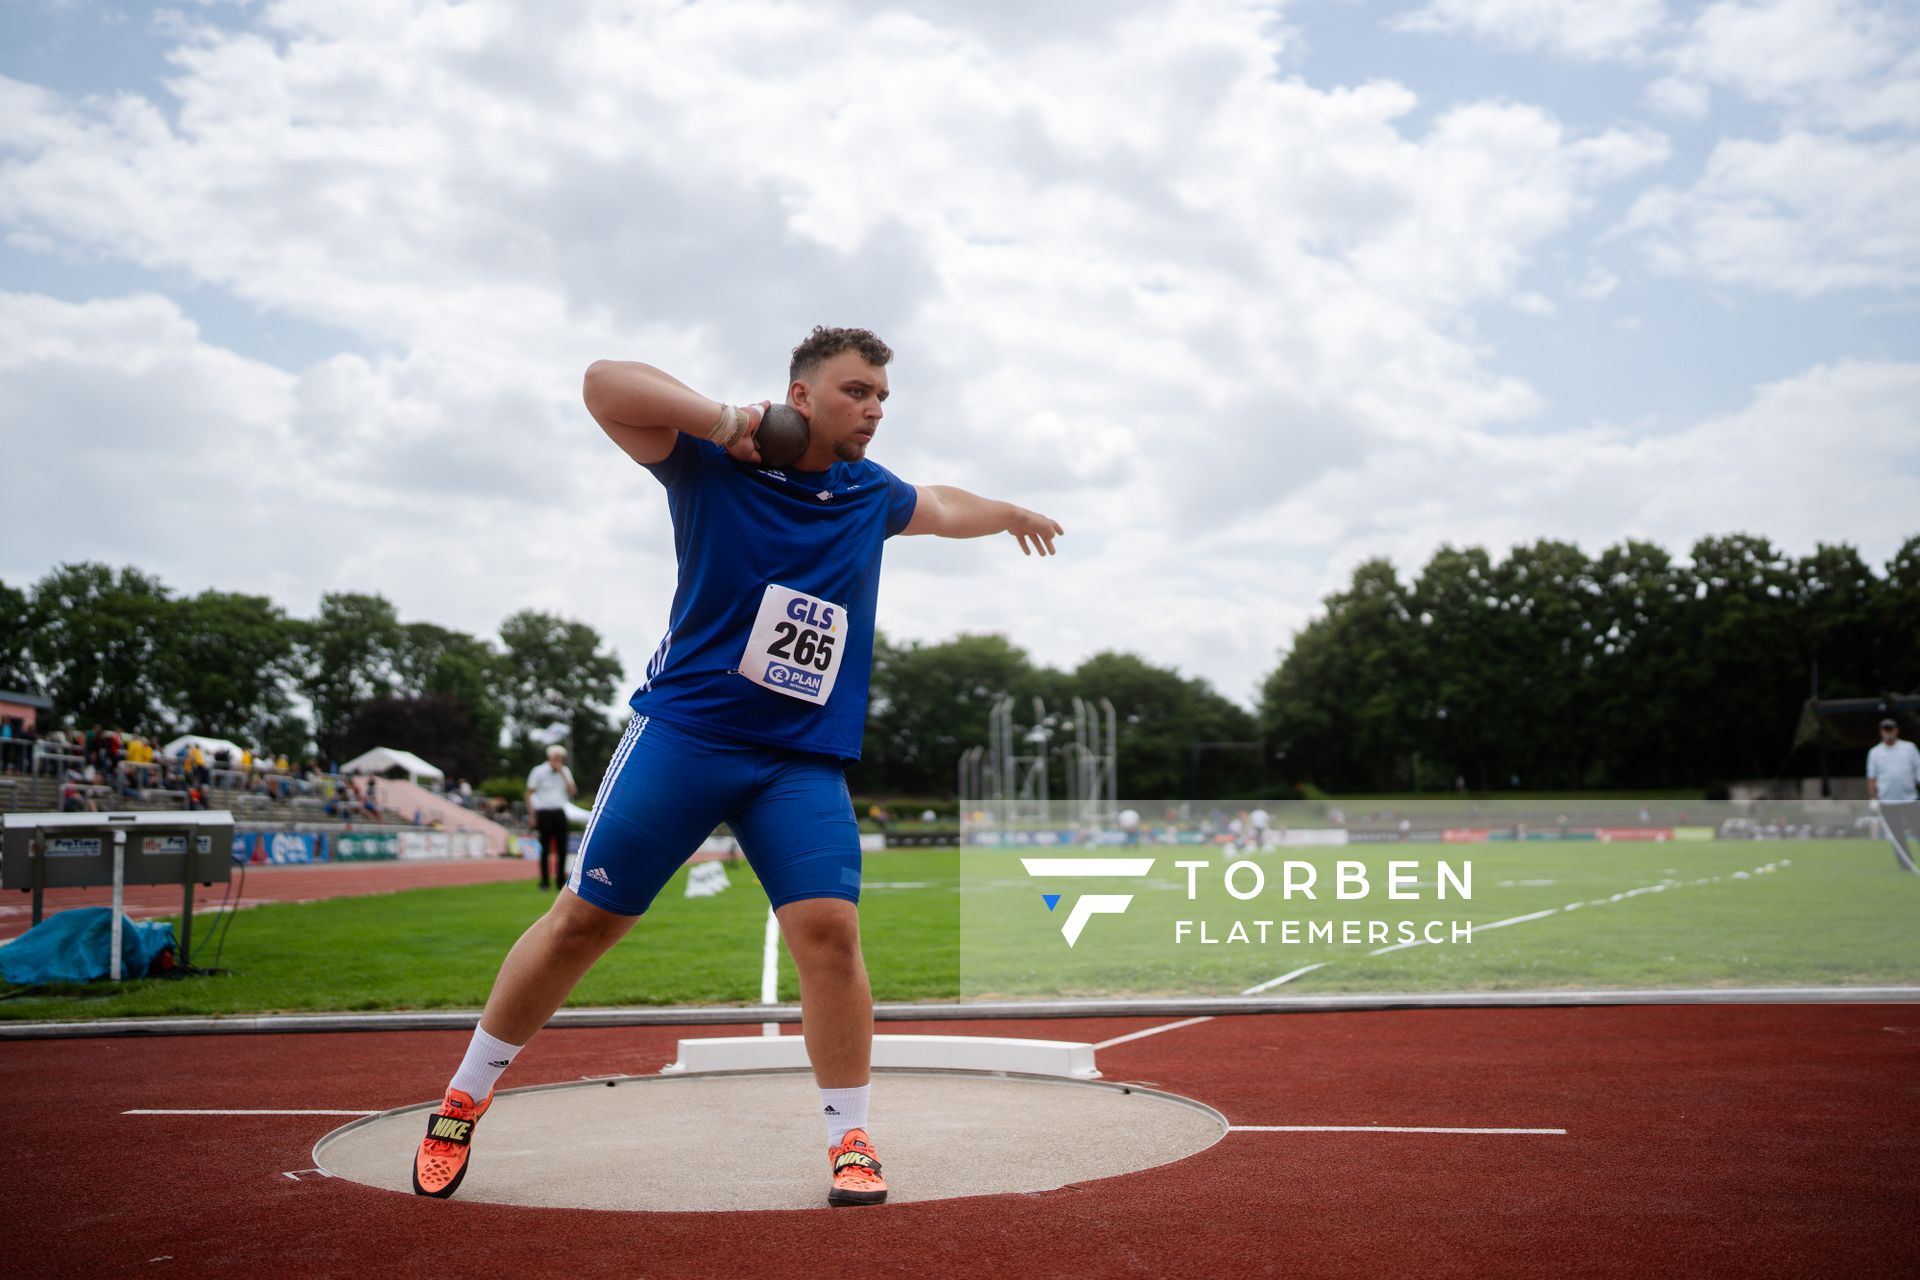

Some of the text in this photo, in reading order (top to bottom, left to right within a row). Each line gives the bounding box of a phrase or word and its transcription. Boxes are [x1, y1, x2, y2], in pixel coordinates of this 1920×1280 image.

[766, 621, 835, 671] 265
[791, 671, 821, 689] PLAN
[586, 870, 613, 886] adidas
[431, 1117, 471, 1141] NIKE
[836, 1151, 873, 1170] NIKE
